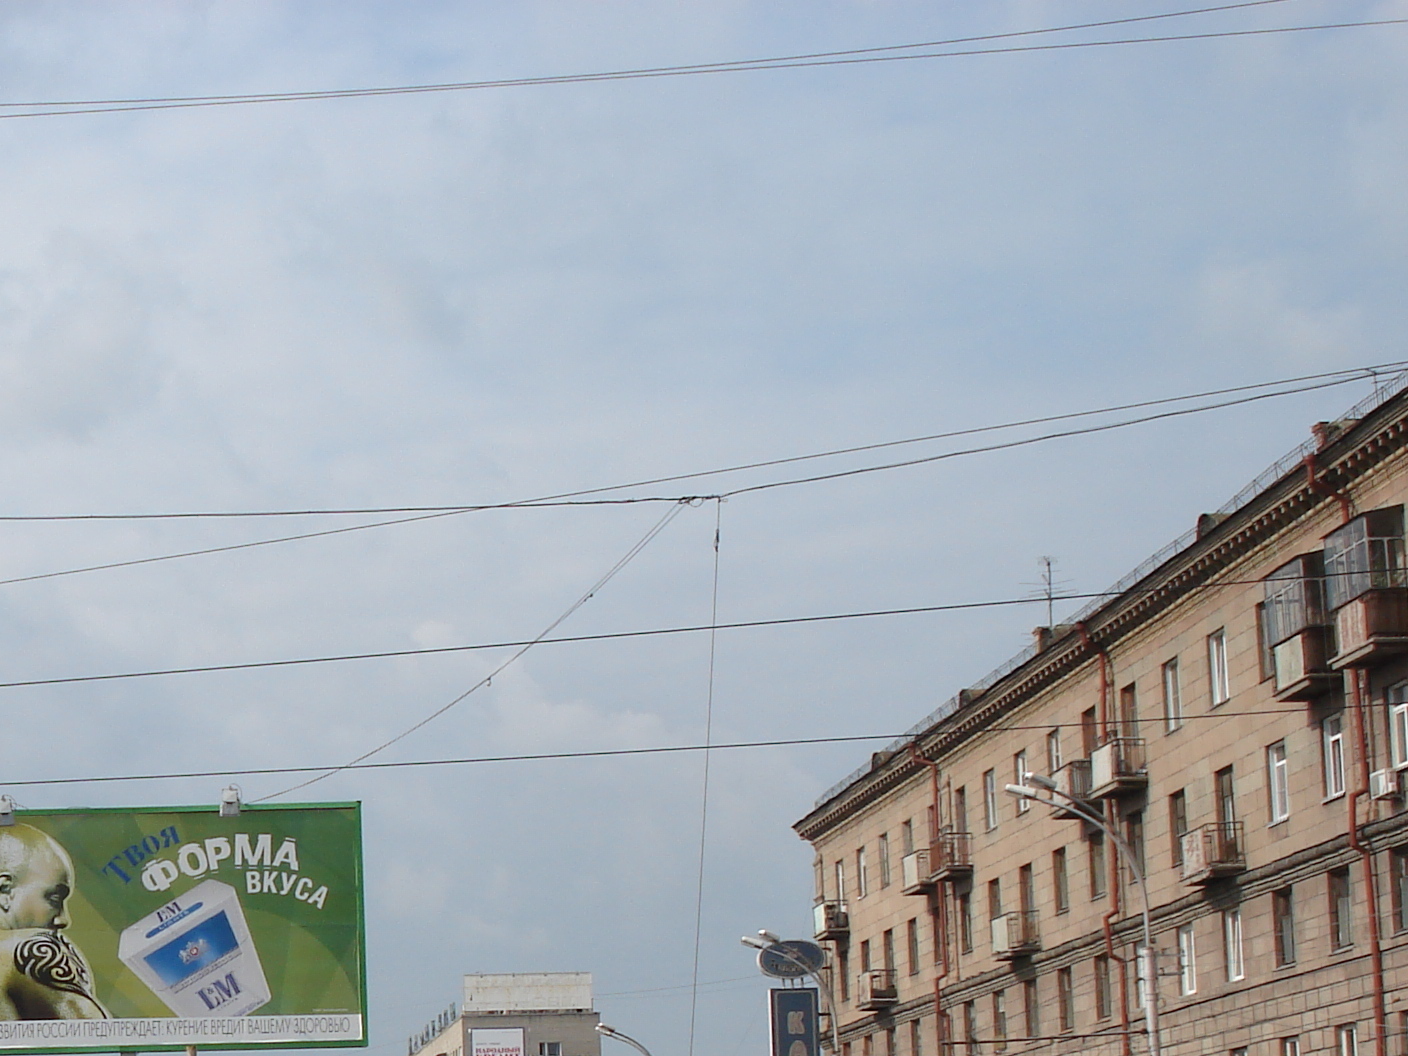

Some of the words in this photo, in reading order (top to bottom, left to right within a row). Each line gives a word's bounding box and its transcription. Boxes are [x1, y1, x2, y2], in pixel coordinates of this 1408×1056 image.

[102, 825, 181, 885] ТВОЯ
[141, 833, 299, 892] ФОРМА
[245, 870, 329, 910] ВКУСА
[37, 1022, 81, 1039] РОССИИ
[166, 1018, 209, 1036] КУРЕНИЕ
[210, 1018, 247, 1036] ВРЕДИТ
[248, 1017, 292, 1035] ВАШЕМУ
[293, 1016, 351, 1035] ЗДОРОВЬЮ
